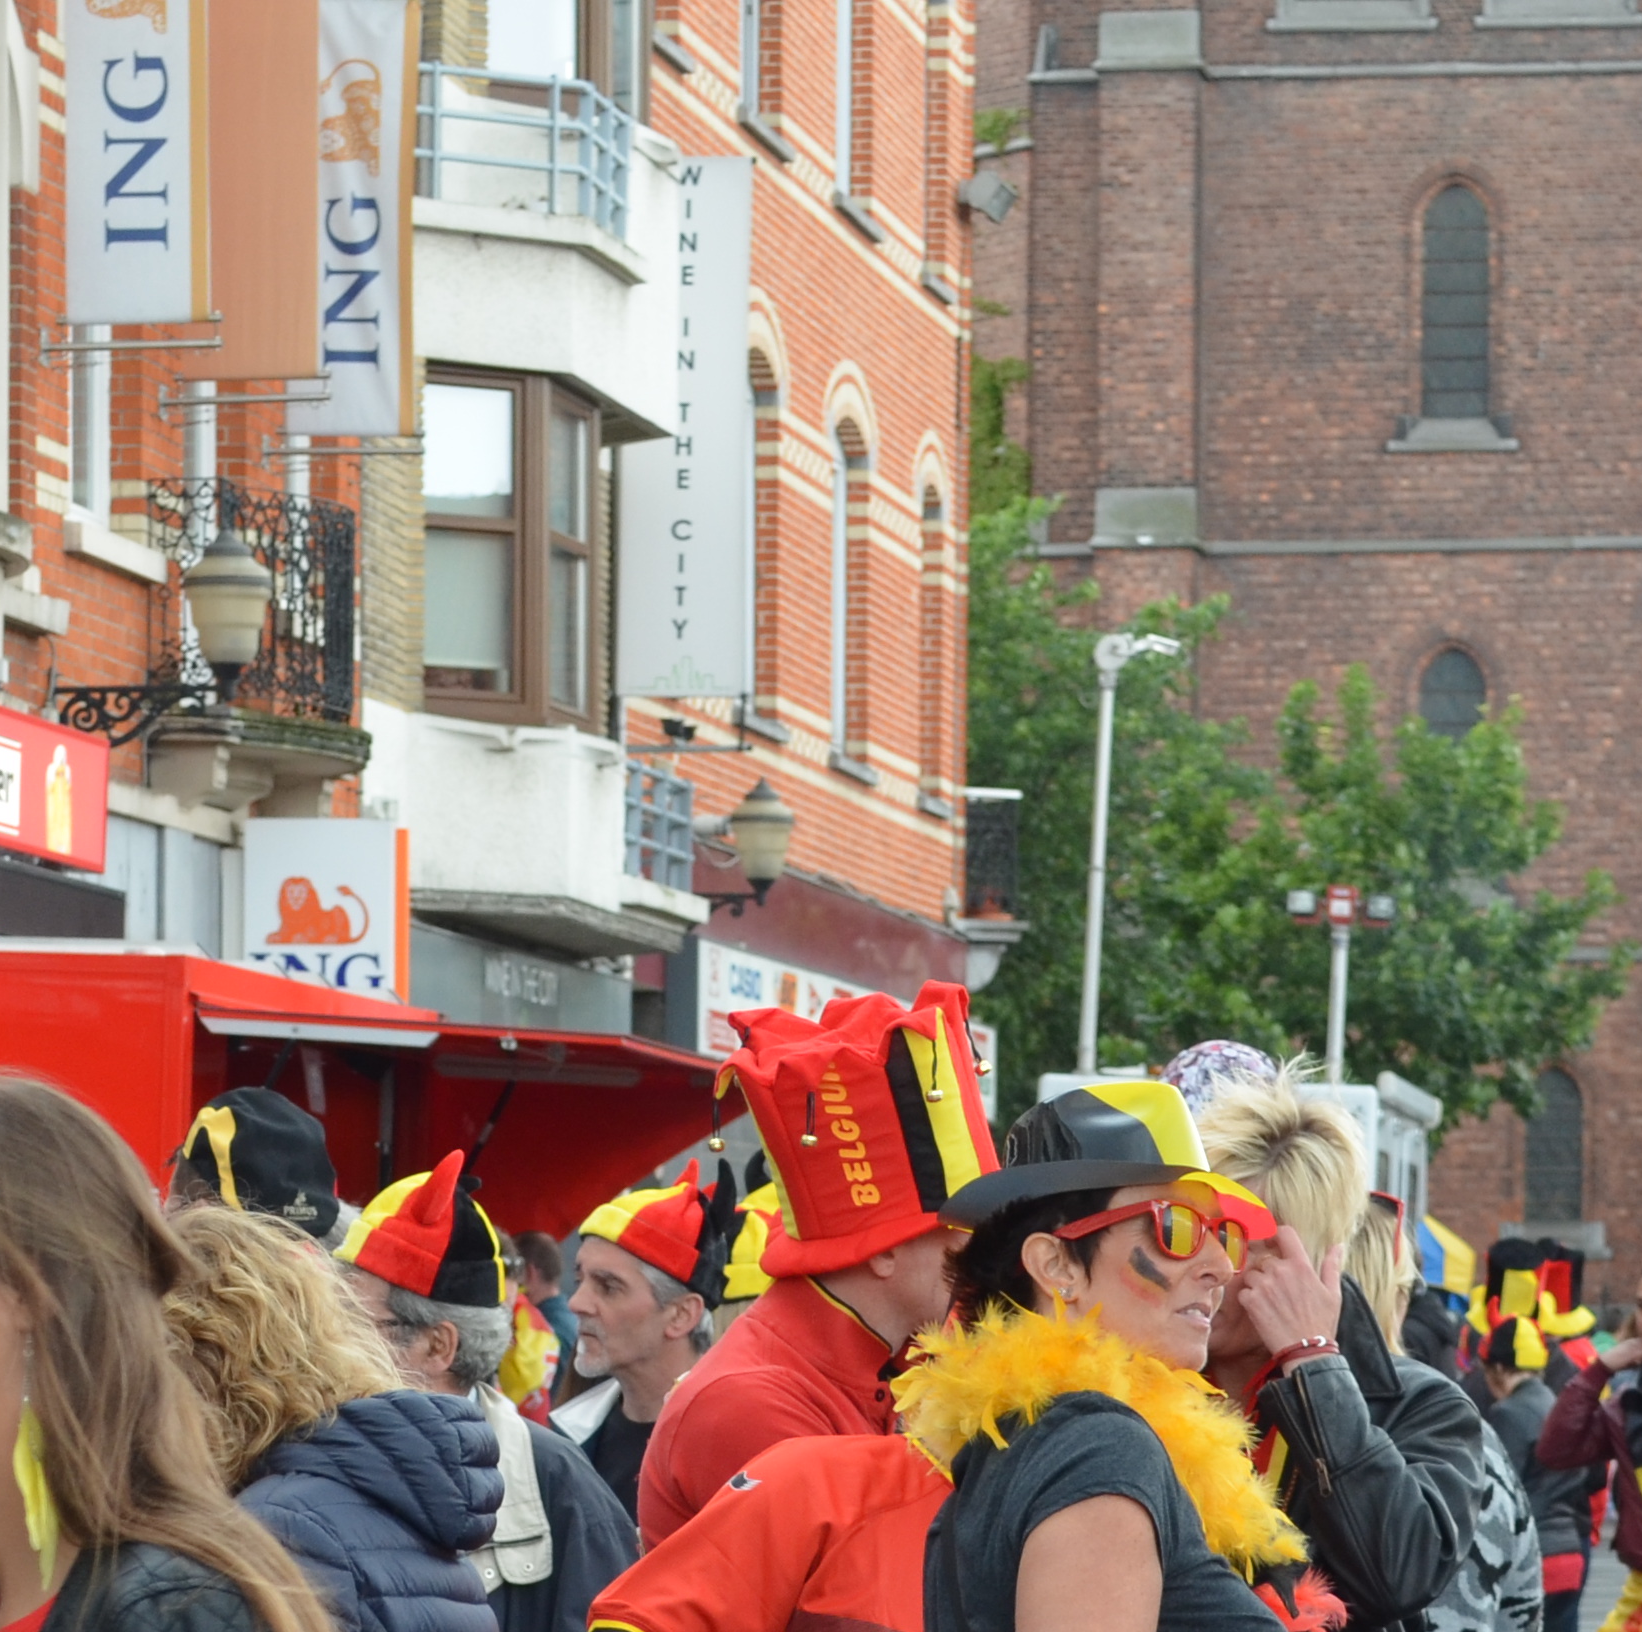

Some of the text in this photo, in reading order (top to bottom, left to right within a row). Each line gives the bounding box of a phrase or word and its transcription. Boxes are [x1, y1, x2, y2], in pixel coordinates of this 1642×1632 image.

[103, 51, 169, 252] ING
[323, 191, 382, 372] ING
[670, 165, 703, 640] WINE IN THE CITY
[818, 1061, 881, 1207] BELGIU
